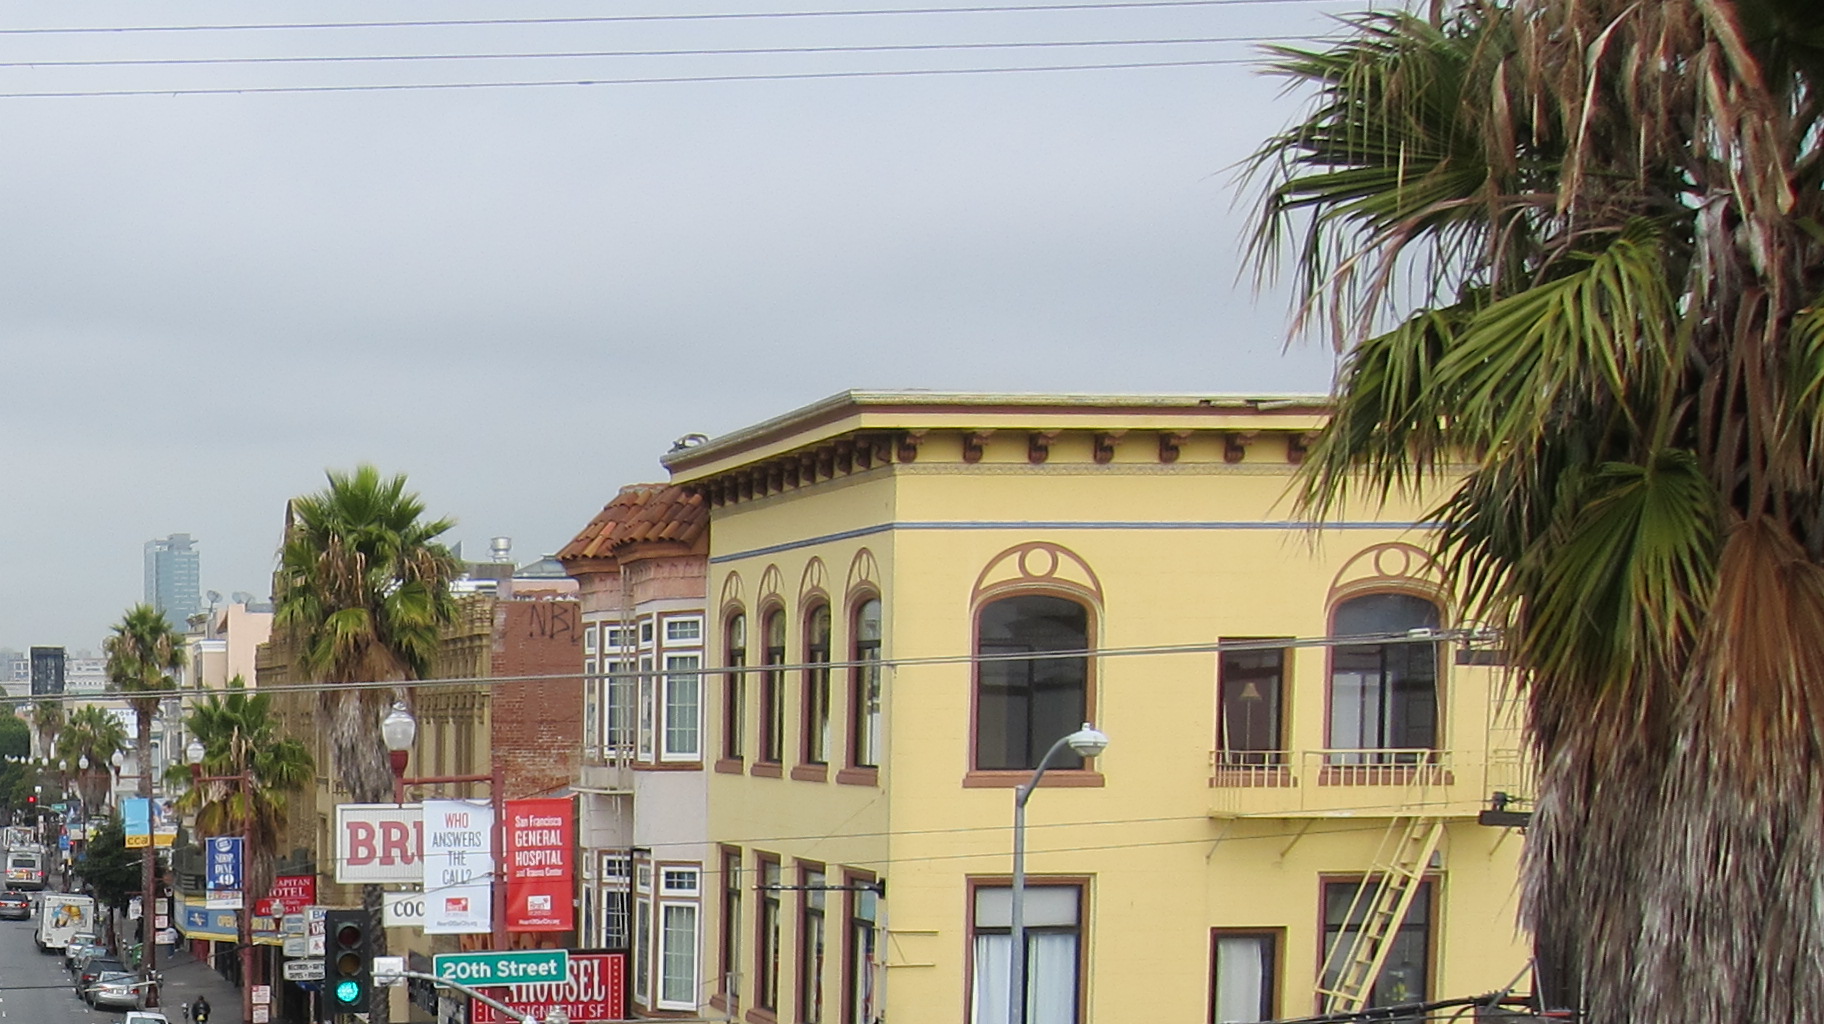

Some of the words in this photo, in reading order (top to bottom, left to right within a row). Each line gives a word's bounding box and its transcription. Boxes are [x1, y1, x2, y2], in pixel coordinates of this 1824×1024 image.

[445, 813, 469, 828] WHO
[515, 816, 528, 827] San
[529, 814, 562, 827] Francisco
[127, 836, 149, 845] cca
[431, 832, 482, 847] ANSWERS
[515, 830, 563, 846] GENERAL
[447, 851, 466, 866] THE
[515, 850, 563, 866] HOSPITAL
[277, 878, 311, 887] APITAN
[441, 869, 473, 885] CALL?
[443, 962, 492, 979] 20th
[496, 959, 558, 977] Street
[490, 1003, 582, 1021] CNSIGNMNT
[588, 1003, 606, 1018] SF
